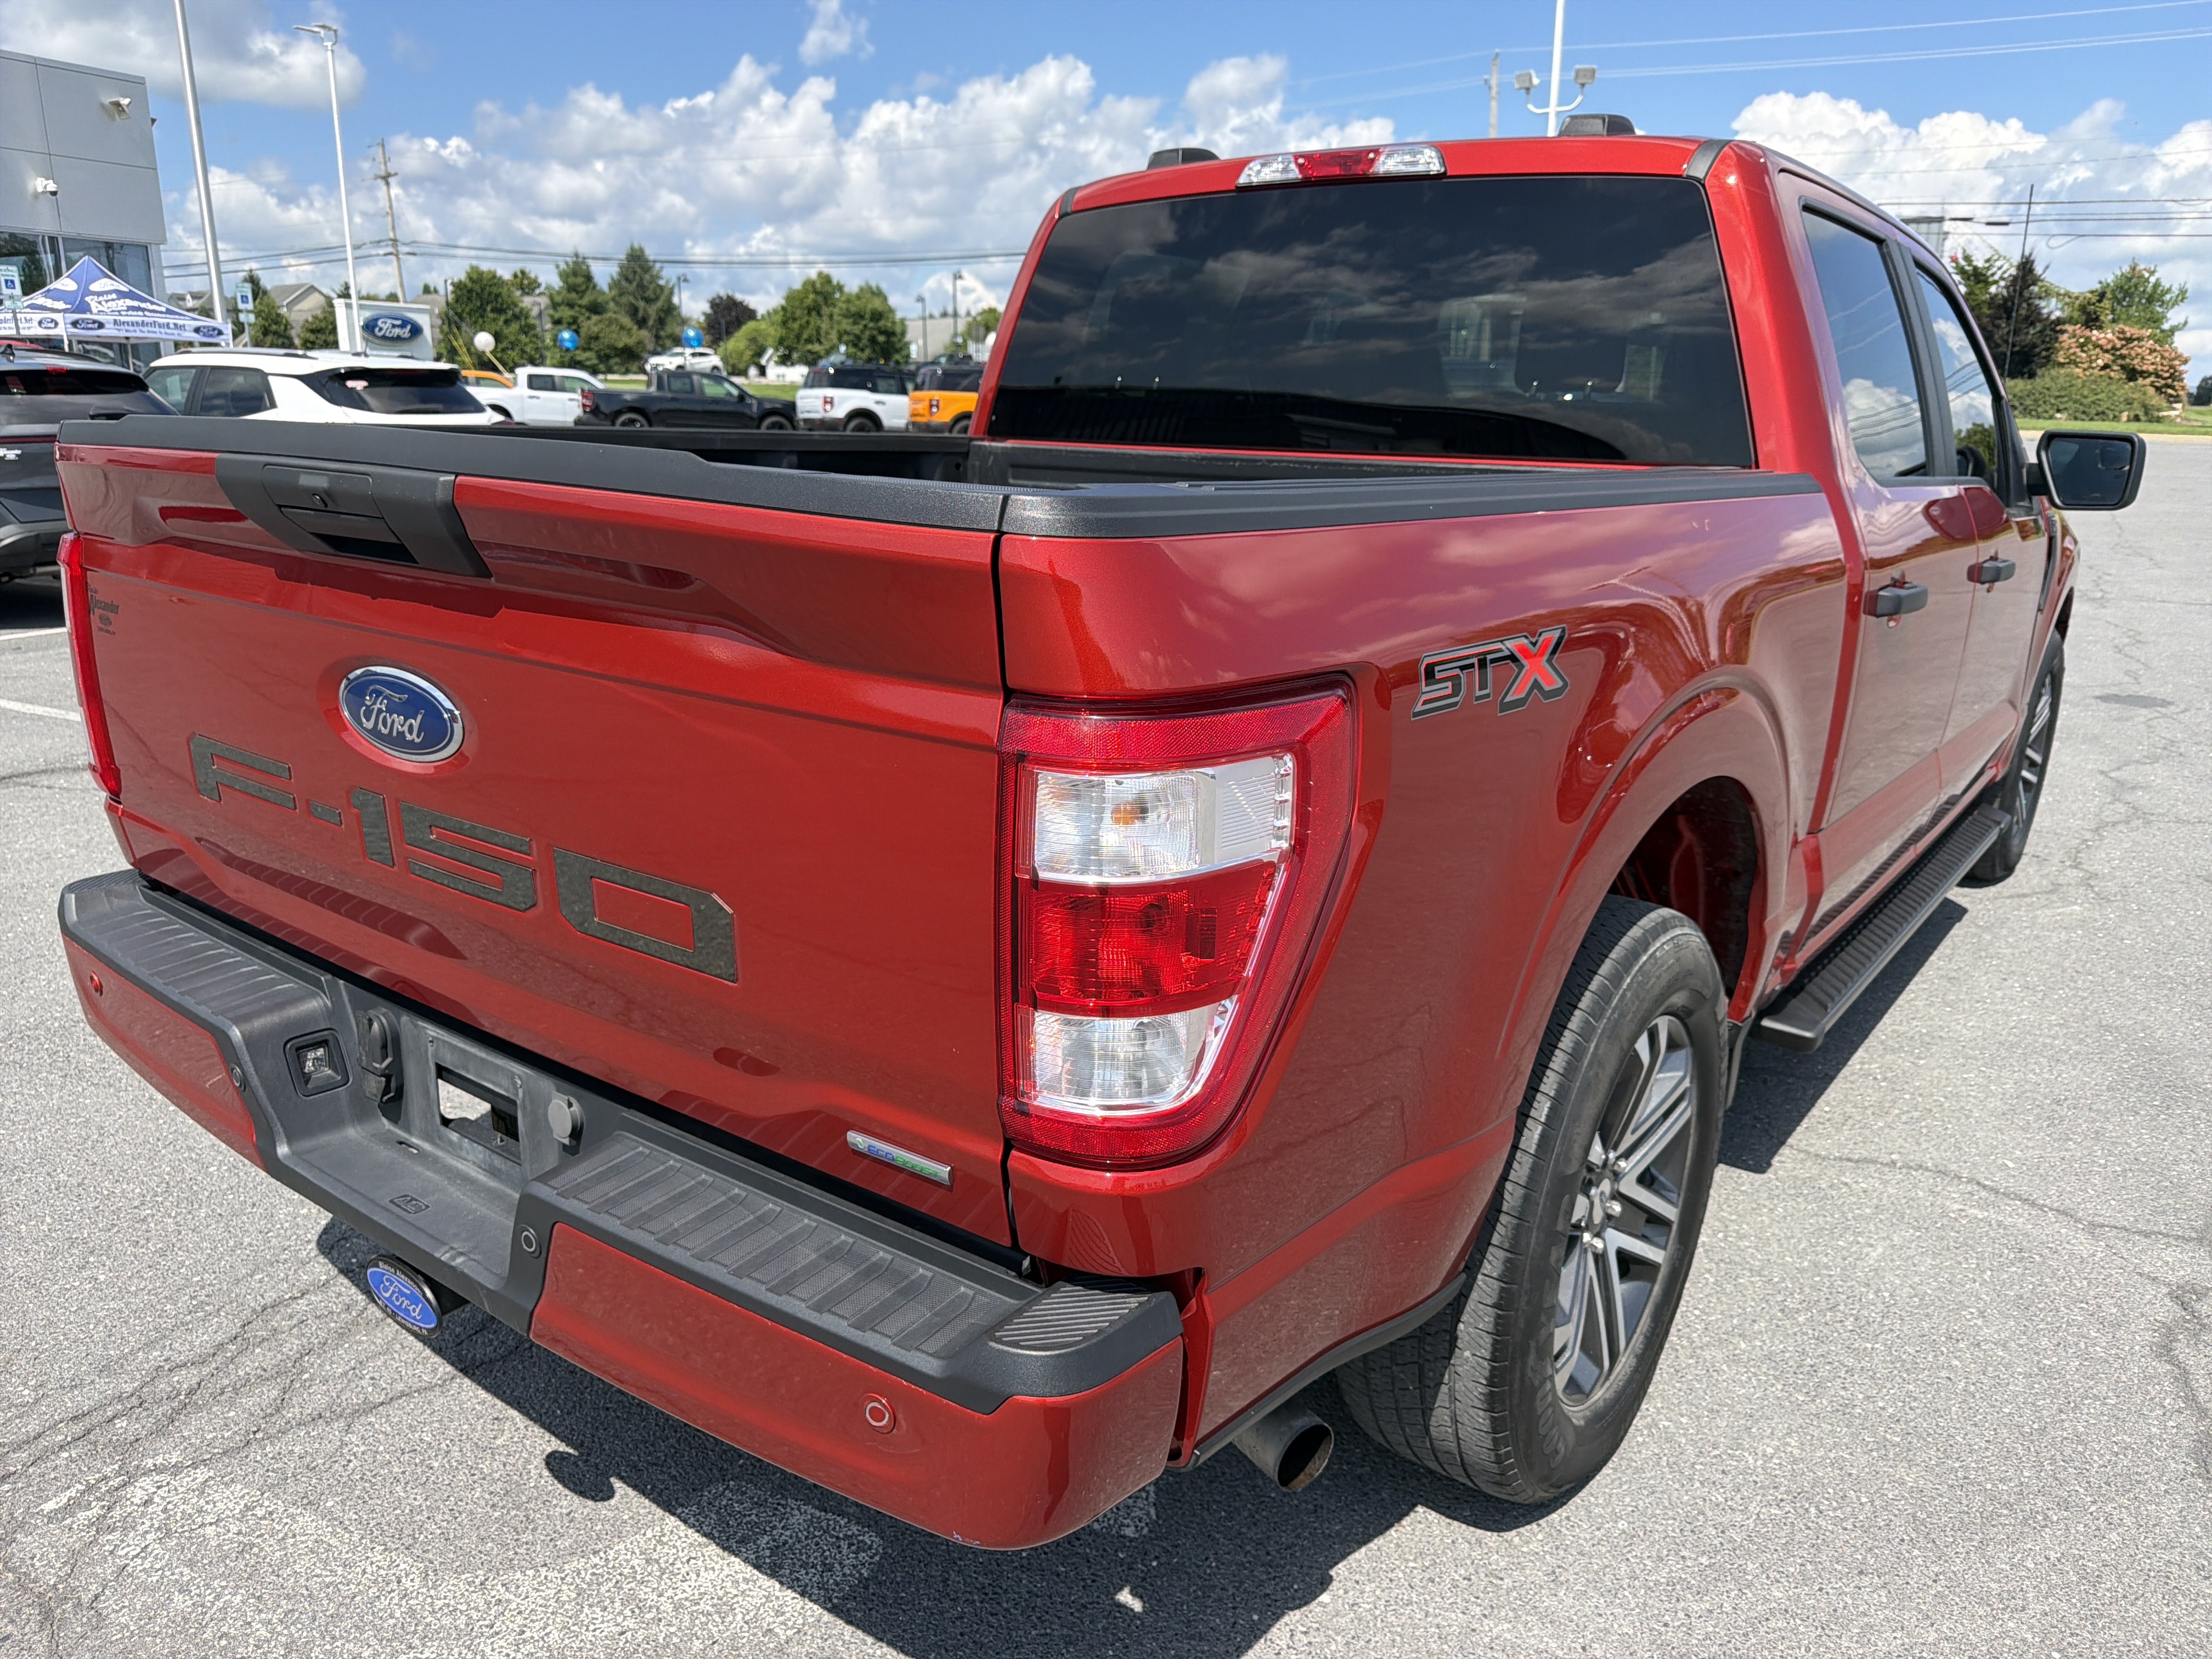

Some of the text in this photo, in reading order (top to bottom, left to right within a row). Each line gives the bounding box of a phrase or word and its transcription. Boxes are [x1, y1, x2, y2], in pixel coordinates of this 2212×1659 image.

[374, 318, 411, 338] Ford
[1411, 624, 1570, 720] STX
[360, 685, 425, 743] Ford
[188, 732, 738, 985] F-150
[380, 1276, 422, 1319] Ford
